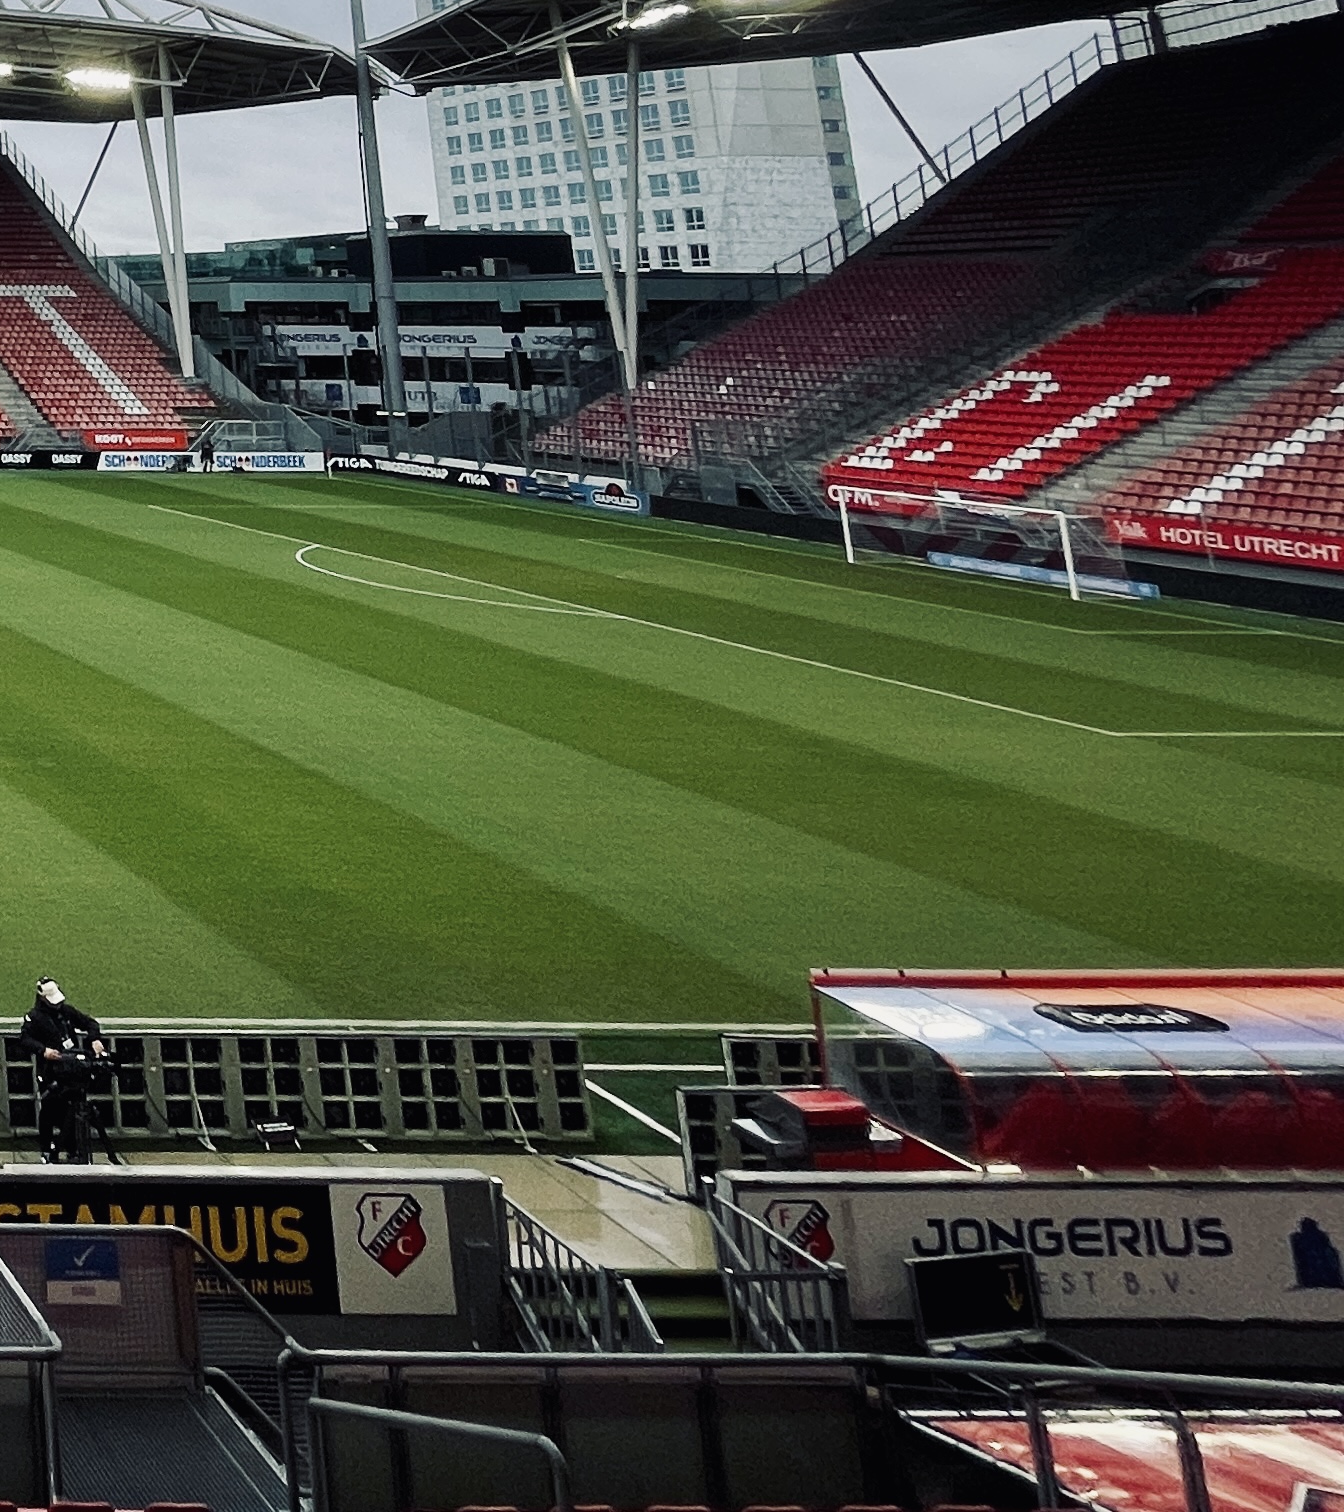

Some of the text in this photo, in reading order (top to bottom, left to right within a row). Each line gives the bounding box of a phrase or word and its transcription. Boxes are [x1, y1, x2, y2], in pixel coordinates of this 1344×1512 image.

[1, 453, 32, 464] DASSY
[51, 454, 83, 465] DASSY
[328, 457, 372, 469] STIGA
[458, 472, 490, 487] STIGA
[1160, 526, 1230, 550] HOTEL
[1234, 534, 1343, 563] UTRECHT
[370, 1200, 382, 1222] F
[779, 1208, 791, 1228] F
[369, 1197, 418, 1260] UTRECHT
[913, 1216, 1233, 1258] JONGERIUS
[250, 1279, 262, 1295] IN
[273, 1279, 313, 1297] HUIS
[1037, 1271, 1196, 1296] EST B.V.
